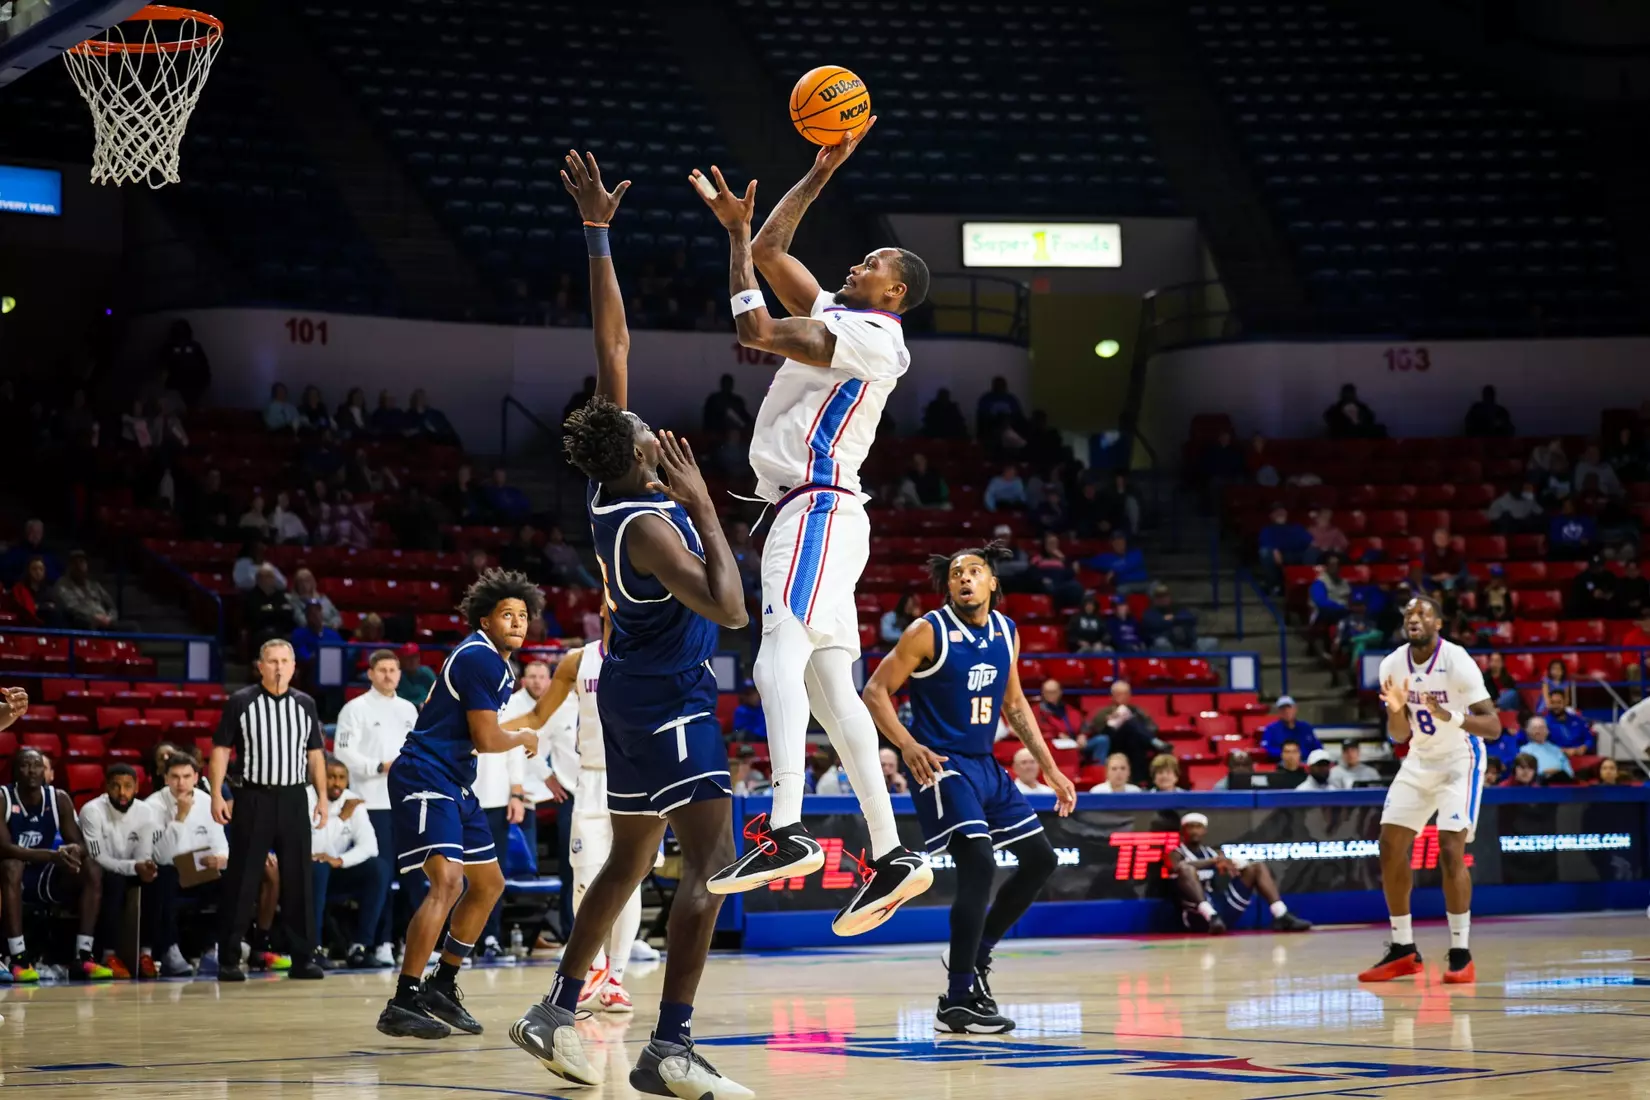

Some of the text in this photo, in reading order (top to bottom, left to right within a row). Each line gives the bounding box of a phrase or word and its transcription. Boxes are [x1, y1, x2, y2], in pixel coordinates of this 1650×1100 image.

[839, 99, 868, 122] NCAA
[284, 317, 327, 346] 101
[967, 662, 998, 692] UTEP
[970, 696, 993, 725] 15
[1416, 709, 1436, 736] 8
[1499, 833, 1631, 852] TICKETSFORLESS.COM
